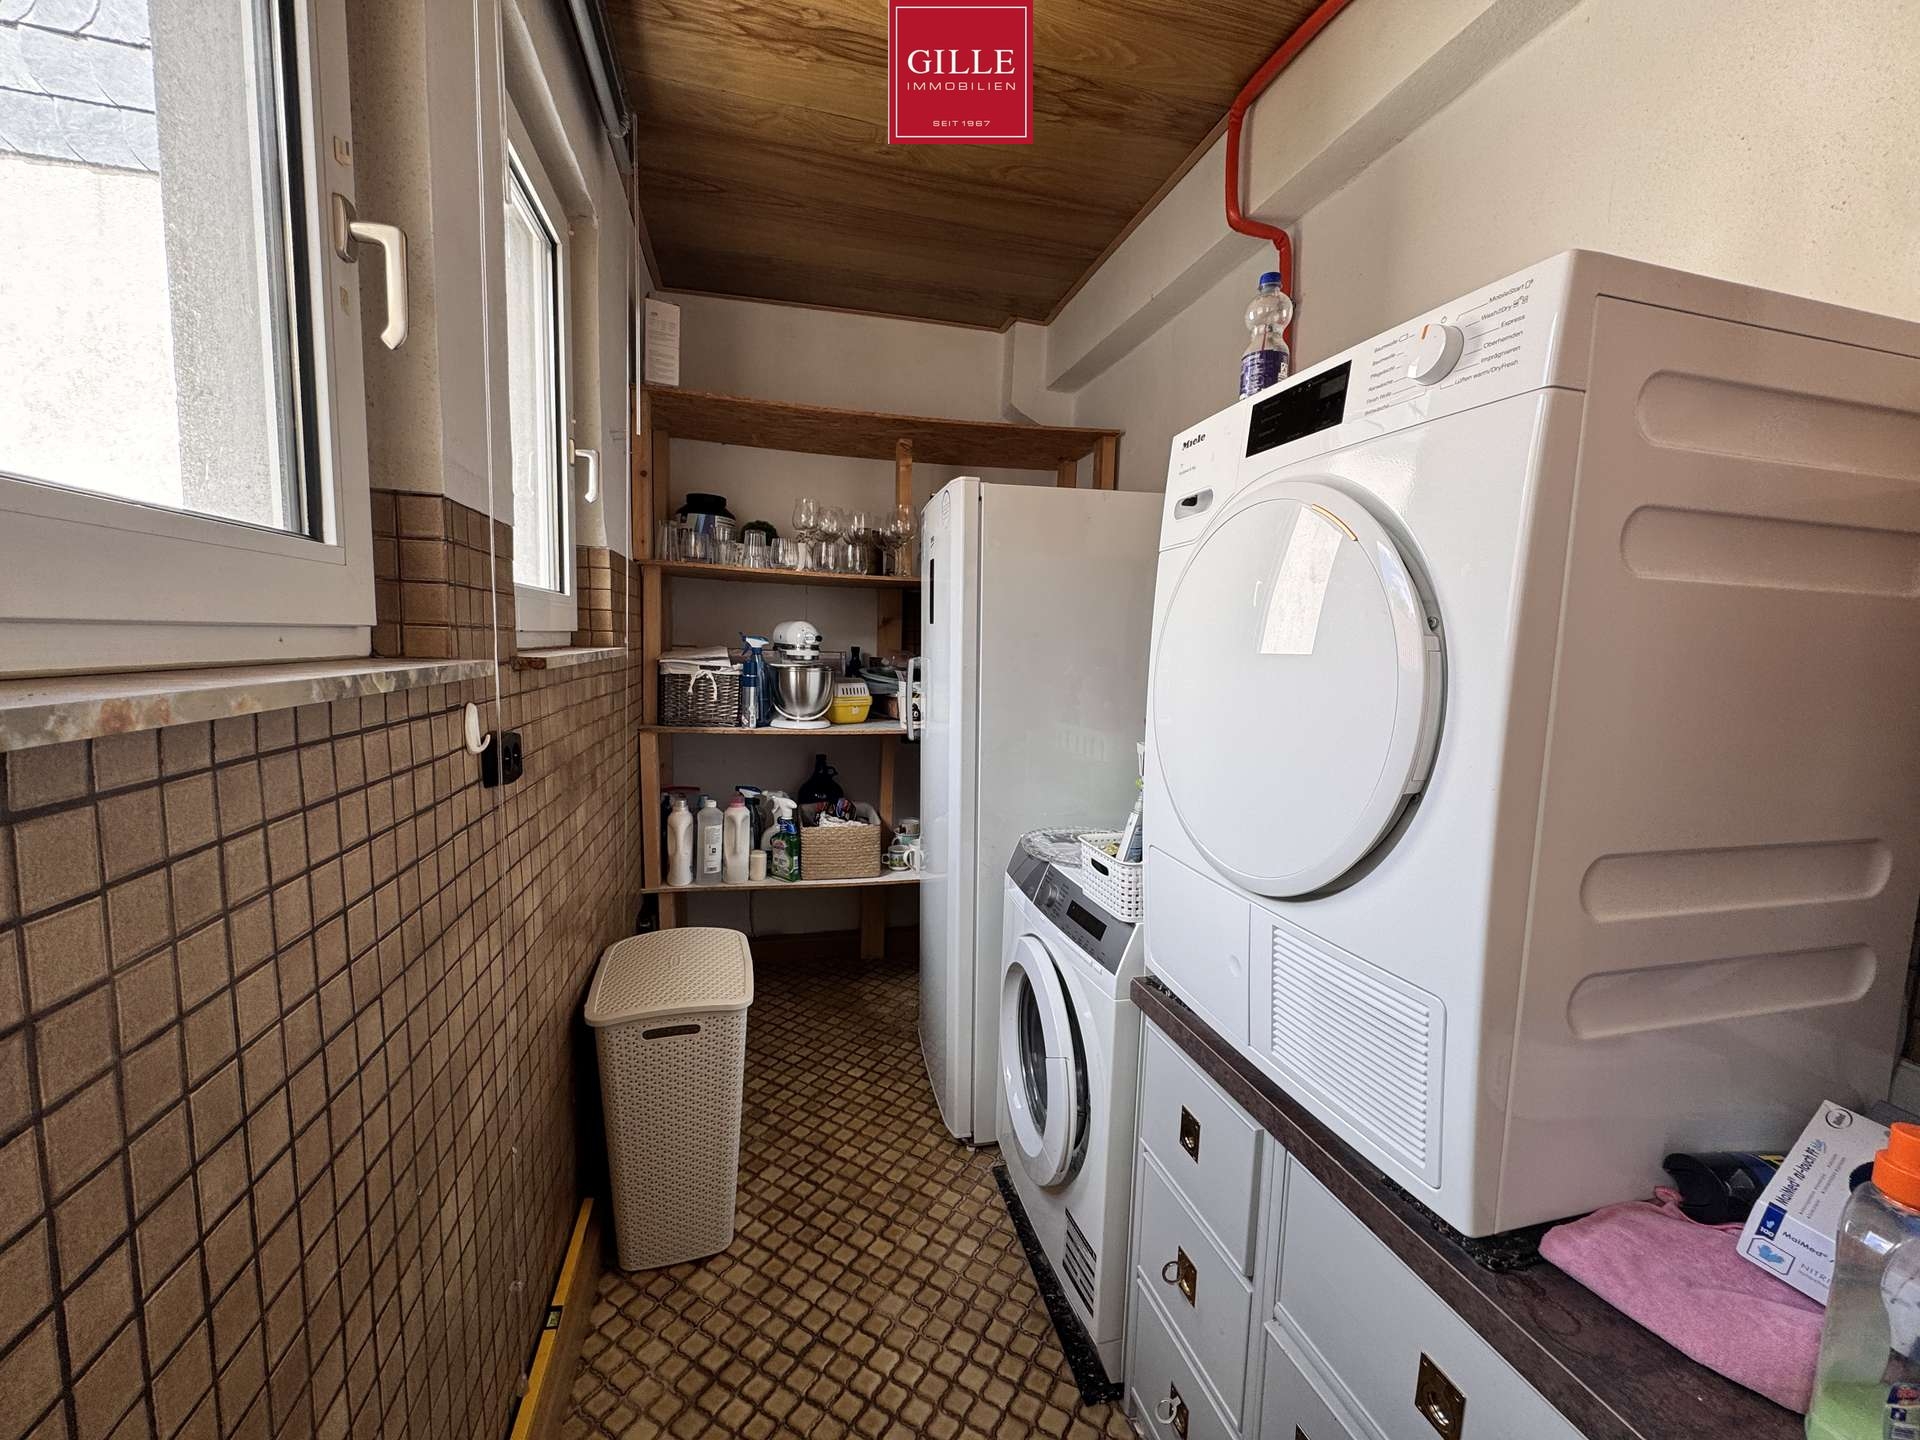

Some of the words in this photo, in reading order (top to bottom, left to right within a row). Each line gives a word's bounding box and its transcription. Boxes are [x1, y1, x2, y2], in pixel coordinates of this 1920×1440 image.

[1182, 433, 1206, 451] Miele
[1760, 1226, 1775, 1239] 100
[1800, 1263, 1831, 1284] NITRI
